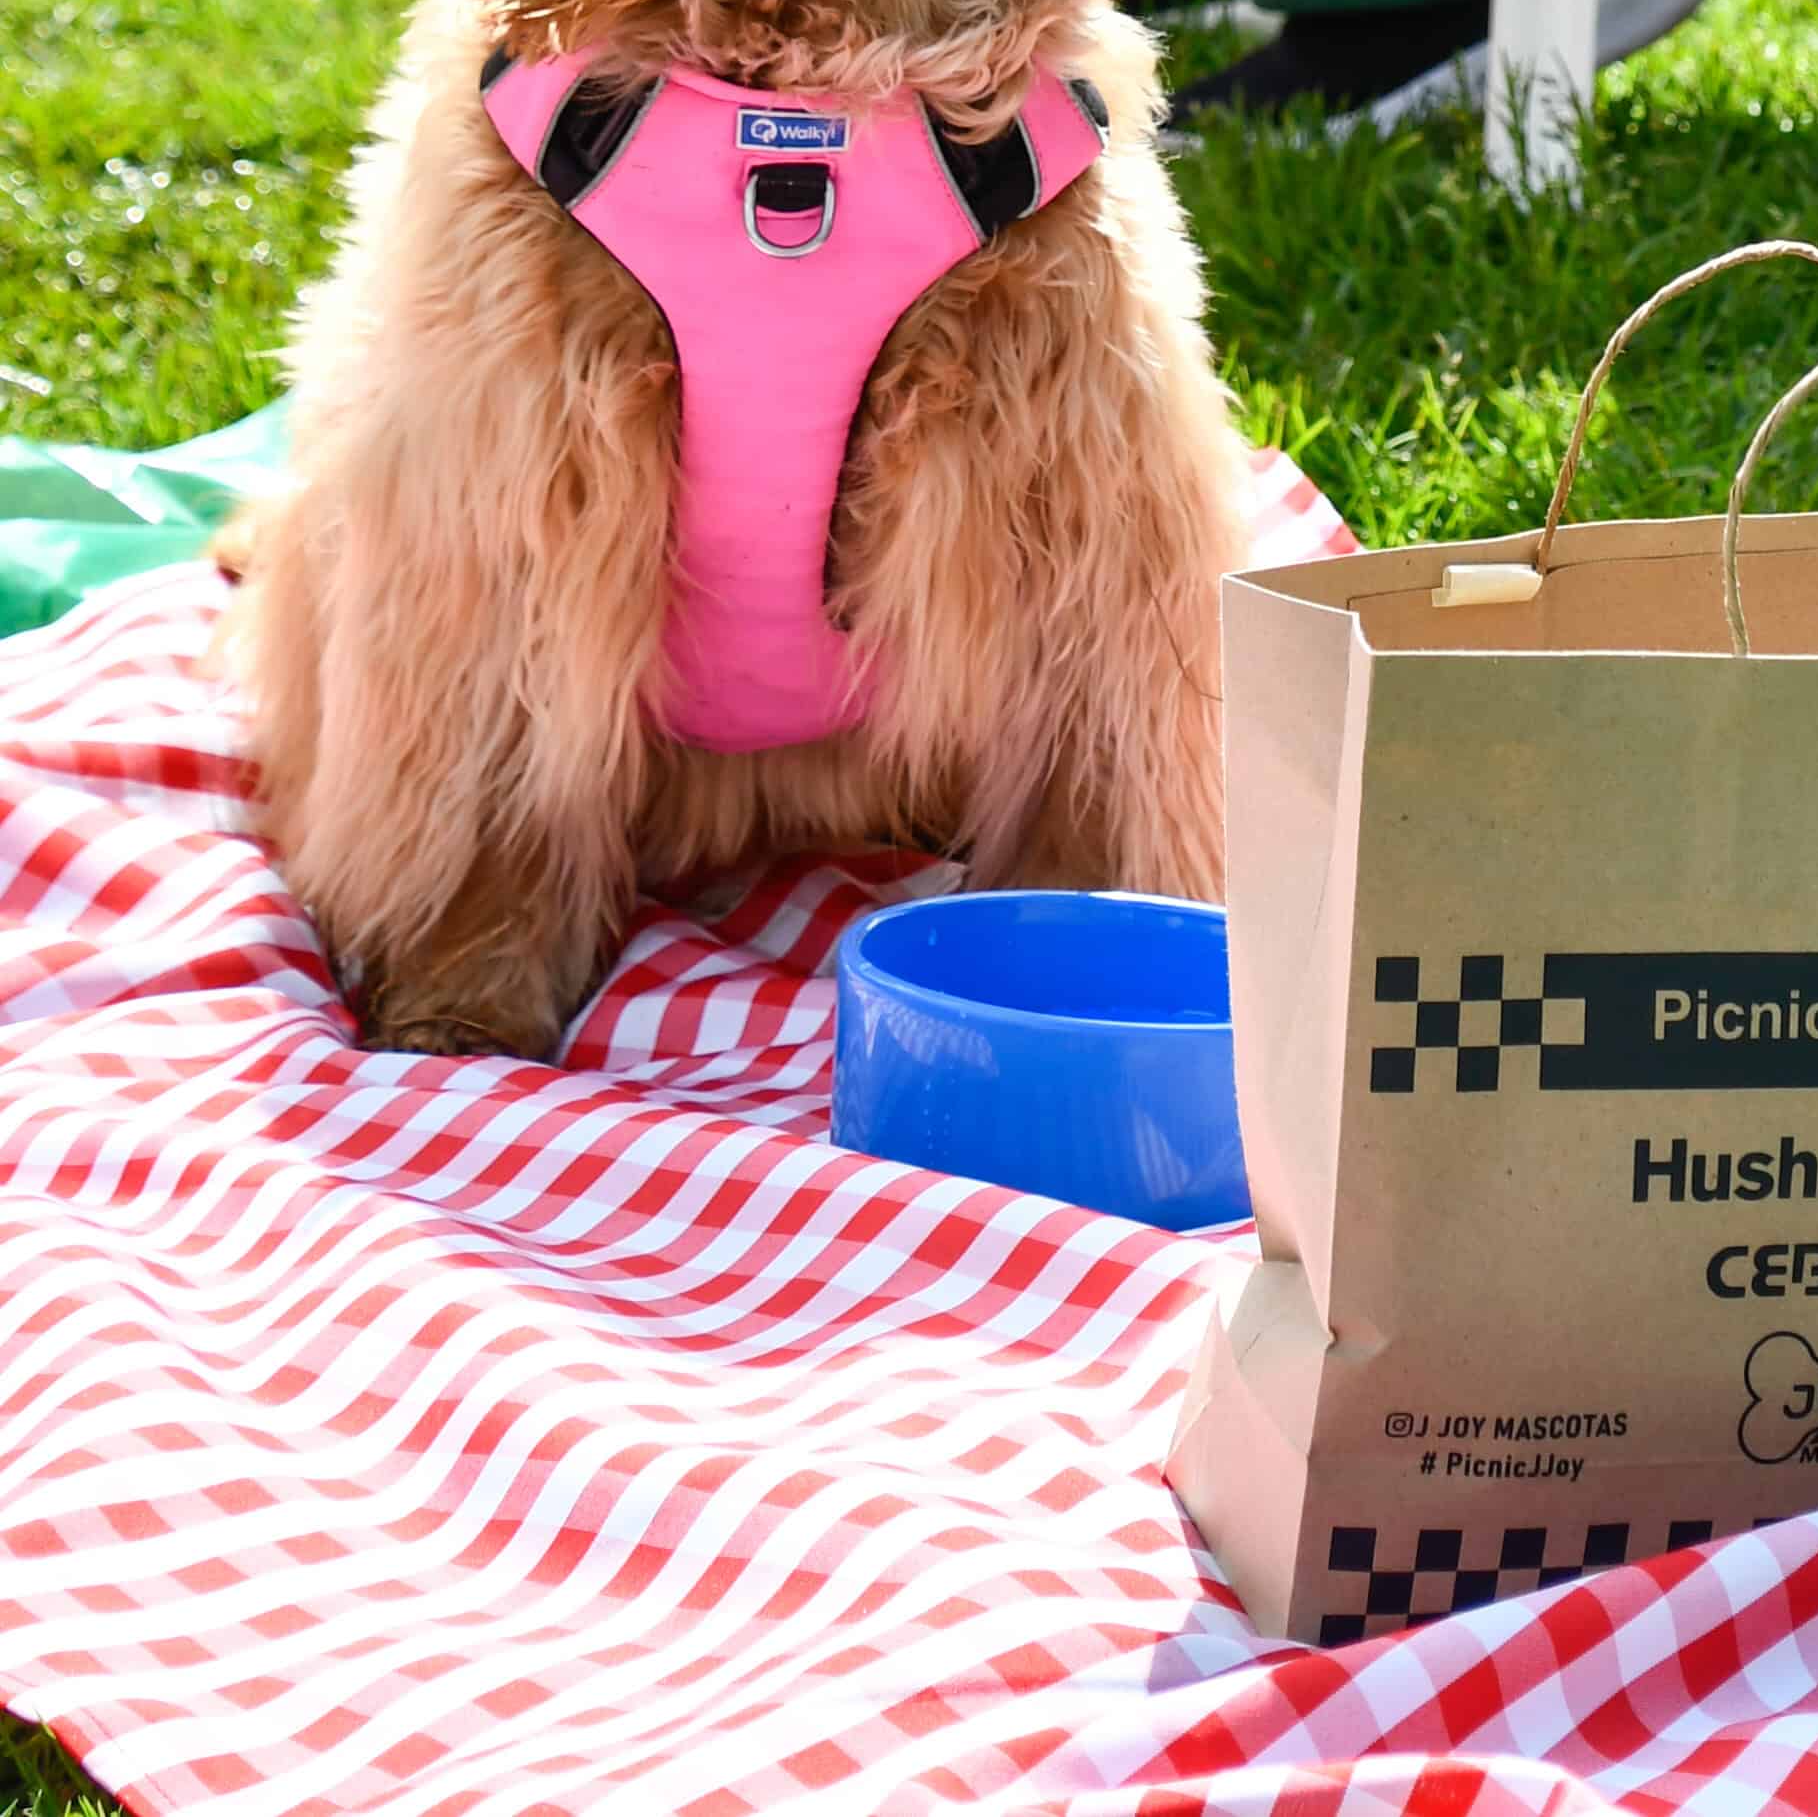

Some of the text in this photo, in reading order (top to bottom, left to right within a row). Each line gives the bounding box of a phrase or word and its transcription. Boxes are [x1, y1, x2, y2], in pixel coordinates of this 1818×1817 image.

[1631, 1136, 1818, 1203] Hush
[1437, 1416, 1487, 1439] JOY
[1493, 1413, 1628, 1440] MASCOTAS
